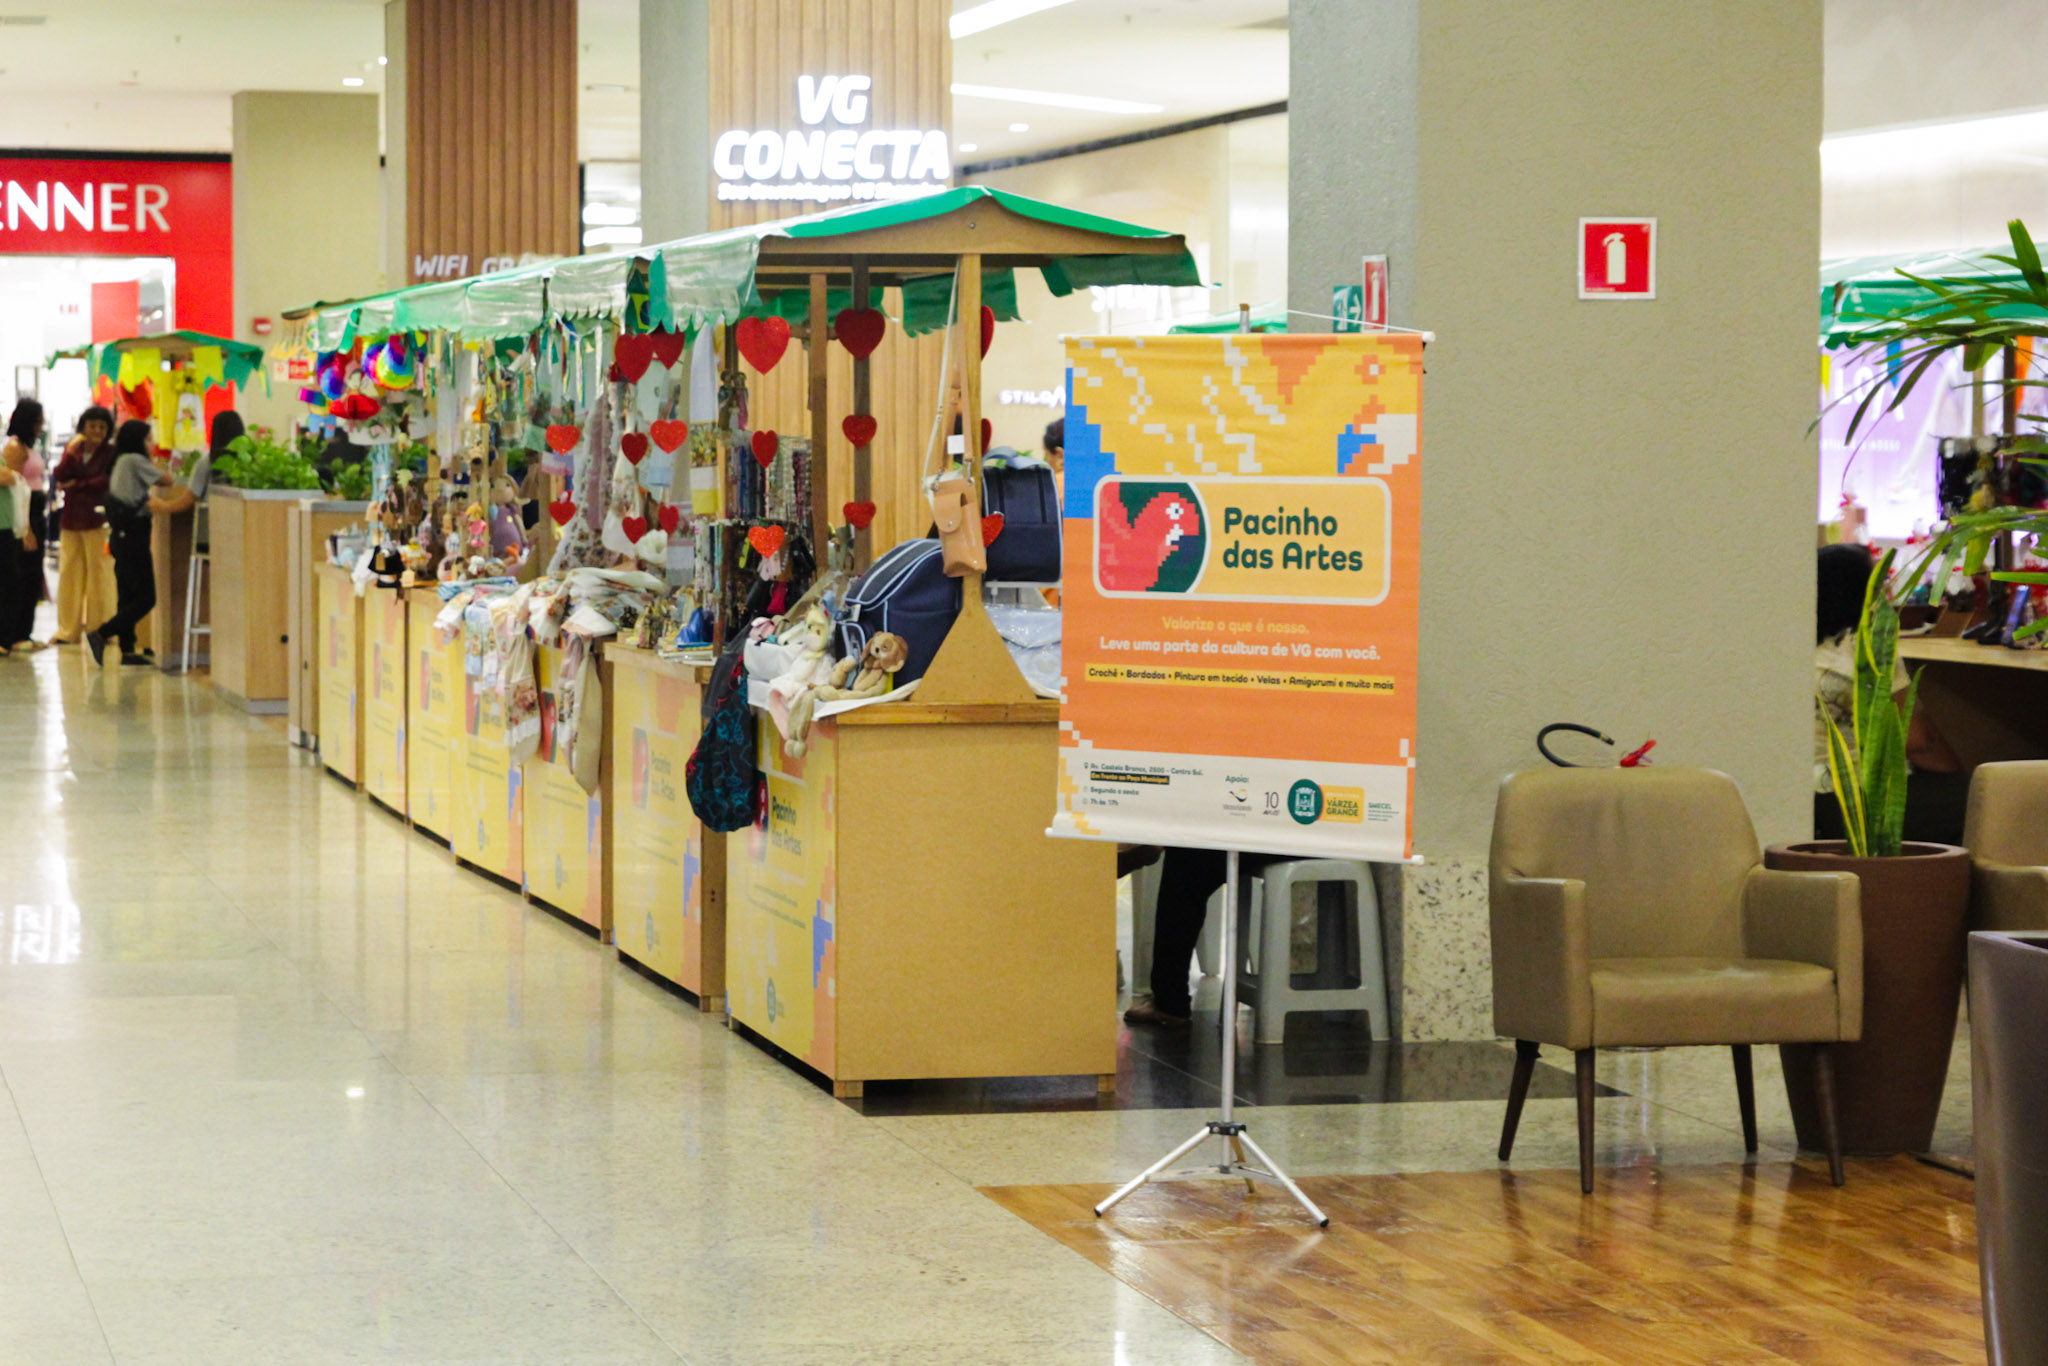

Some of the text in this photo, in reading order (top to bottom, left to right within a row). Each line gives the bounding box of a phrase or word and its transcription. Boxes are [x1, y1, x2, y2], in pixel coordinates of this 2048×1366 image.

[797, 74, 871, 125] VG
[713, 129, 950, 180] CONECTA
[0, 179, 171, 232] NNER
[414, 254, 469, 277] WIFI
[1224, 506, 1338, 536] Pacinho
[1223, 539, 1363, 572] das Artes
[1162, 616, 1310, 634] Valorize o que é nosso.
[1100, 636, 1382, 660] Leve uma parte da cultura de VG com você.
[1089, 668, 1118, 678] Crochê
[1126, 669, 1166, 680] Bordados
[1174, 671, 1206, 681] Pintura
[1208, 674, 1220, 682] em
[1222, 673, 1249, 683] tecido
[1256, 675, 1281, 685] Velas
[1289, 676, 1337, 688] Amigurumi
[1346, 678, 1371, 689] muito
[1373, 680, 1394, 690] mais
[1225, 774, 1249, 784] Apoio:
[1264, 791, 1280, 809] 10
[1327, 796, 1358, 808] VÁRZEA
[1327, 807, 1358, 816] GRANDE
